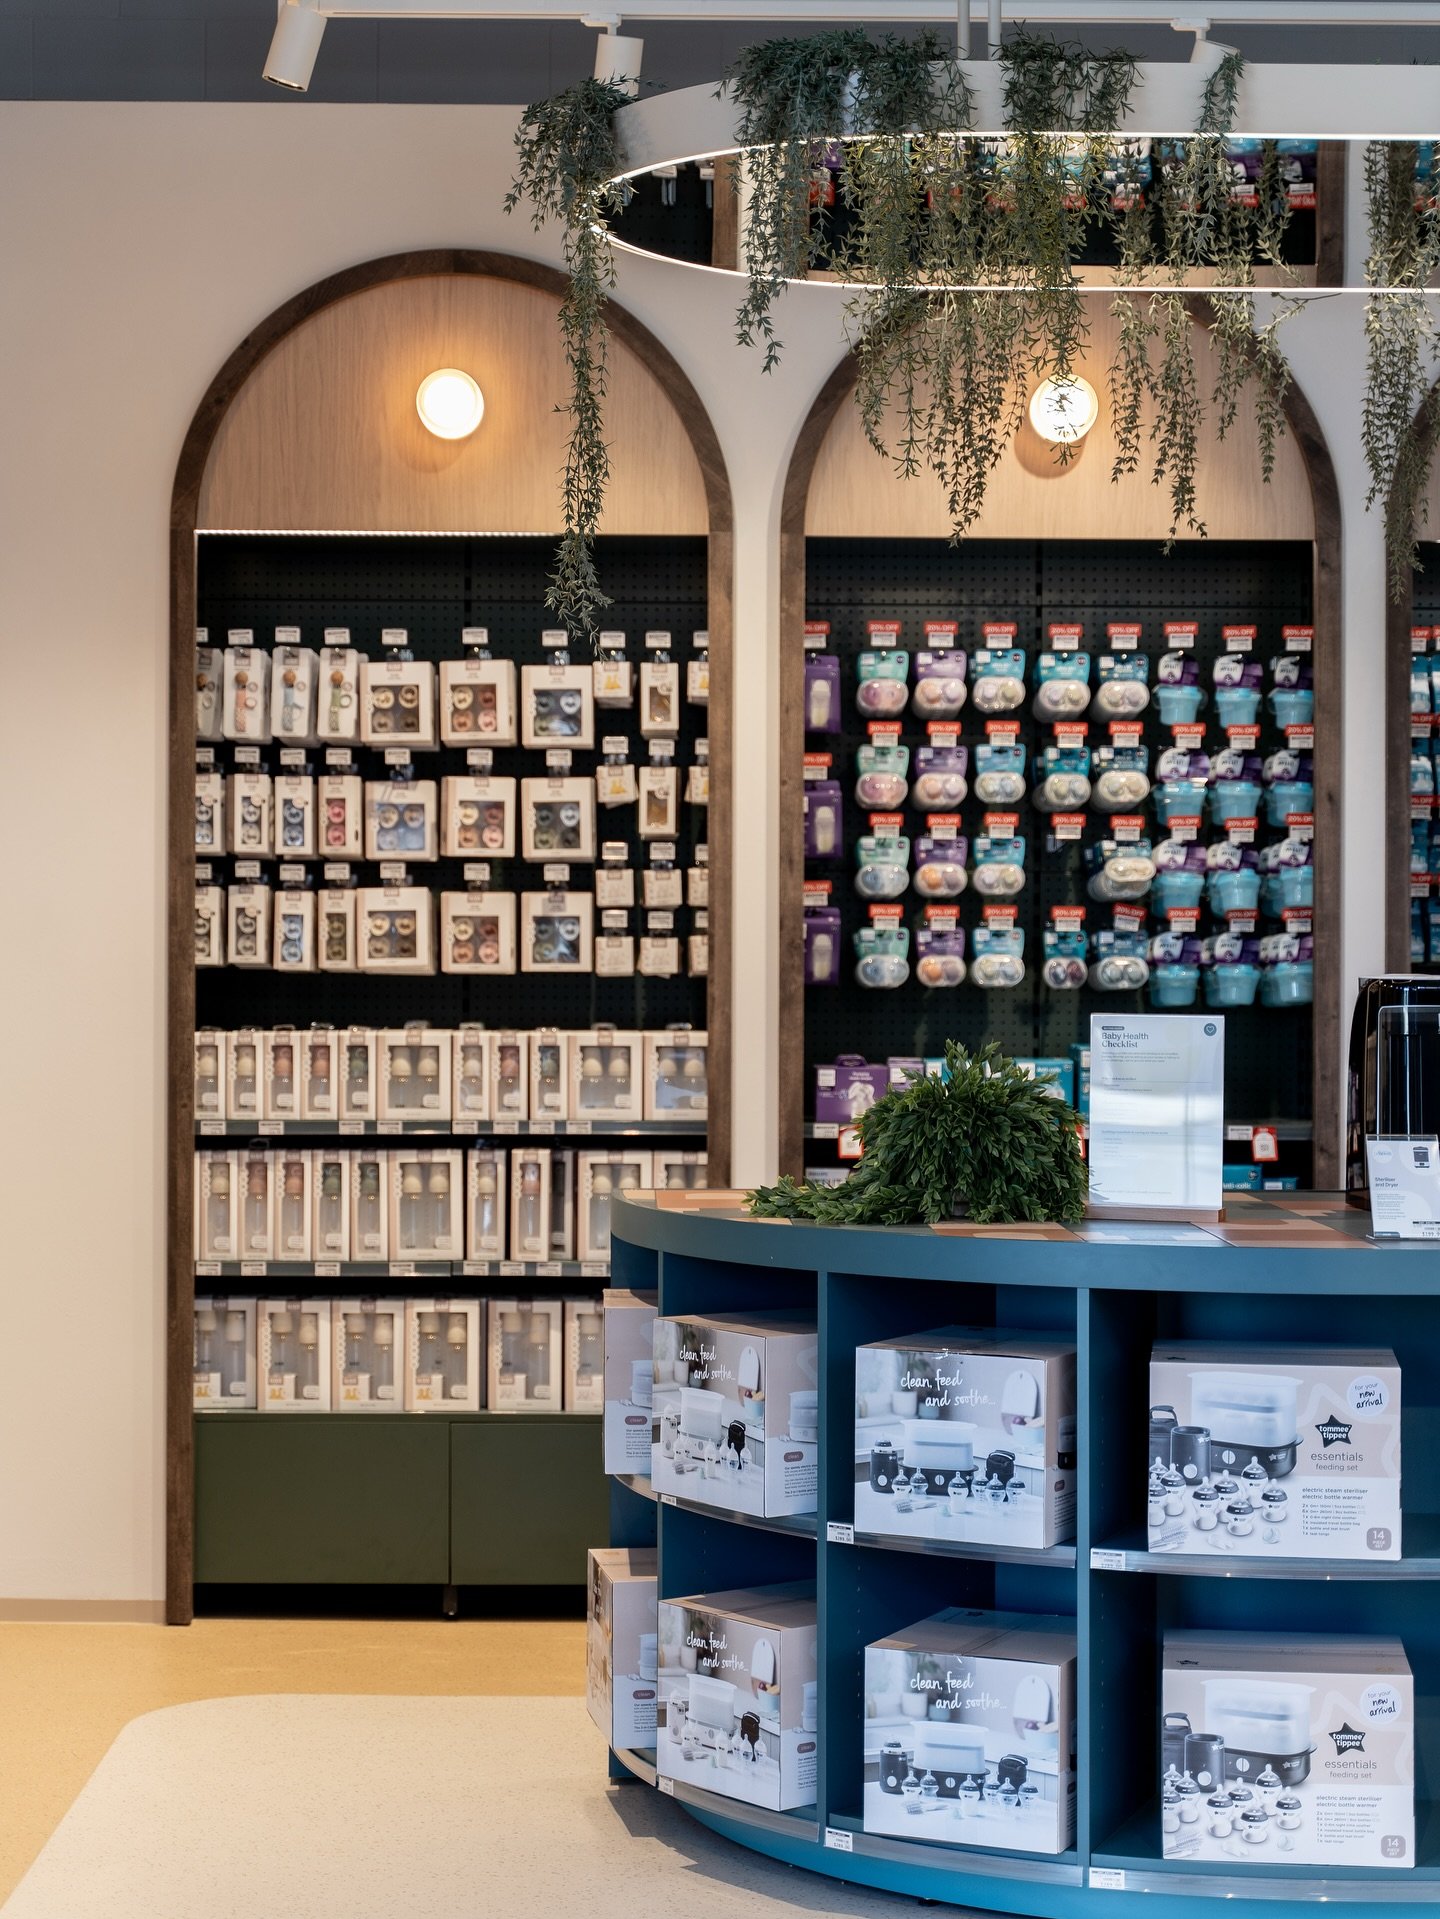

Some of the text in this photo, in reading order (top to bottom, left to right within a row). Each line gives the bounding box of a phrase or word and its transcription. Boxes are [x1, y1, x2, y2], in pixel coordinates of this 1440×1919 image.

[1102, 1032, 1149, 1041] Baby Health
[1102, 1040, 1138, 1048] Checklist
[700, 1344, 717, 1365] feed
[694, 1364, 709, 1379] and
[935, 1369, 963, 1391] feed
[925, 1390, 951, 1407] and
[1360, 1391, 1375, 1399] new
[1356, 1393, 1383, 1408] arrival
[1323, 1432, 1347, 1440] tippee
[1311, 1452, 1363, 1462] essentials
[1316, 1463, 1344, 1472] feeding
[1373, 1531, 1385, 1539] 14
[709, 1632, 728, 1653] feed
[703, 1652, 720, 1668] and
[945, 1671, 974, 1694] feed
[1378, 1690, 1391, 1698] your
[936, 1693, 962, 1709] and
[1373, 1698, 1388, 1706] new
[1370, 1701, 1396, 1716] arrival
[1337, 1740, 1360, 1748] tippee
[1325, 1760, 1377, 1769] essentials
[1330, 1771, 1358, 1779] feeding
[1387, 1839, 1399, 1847] 14
